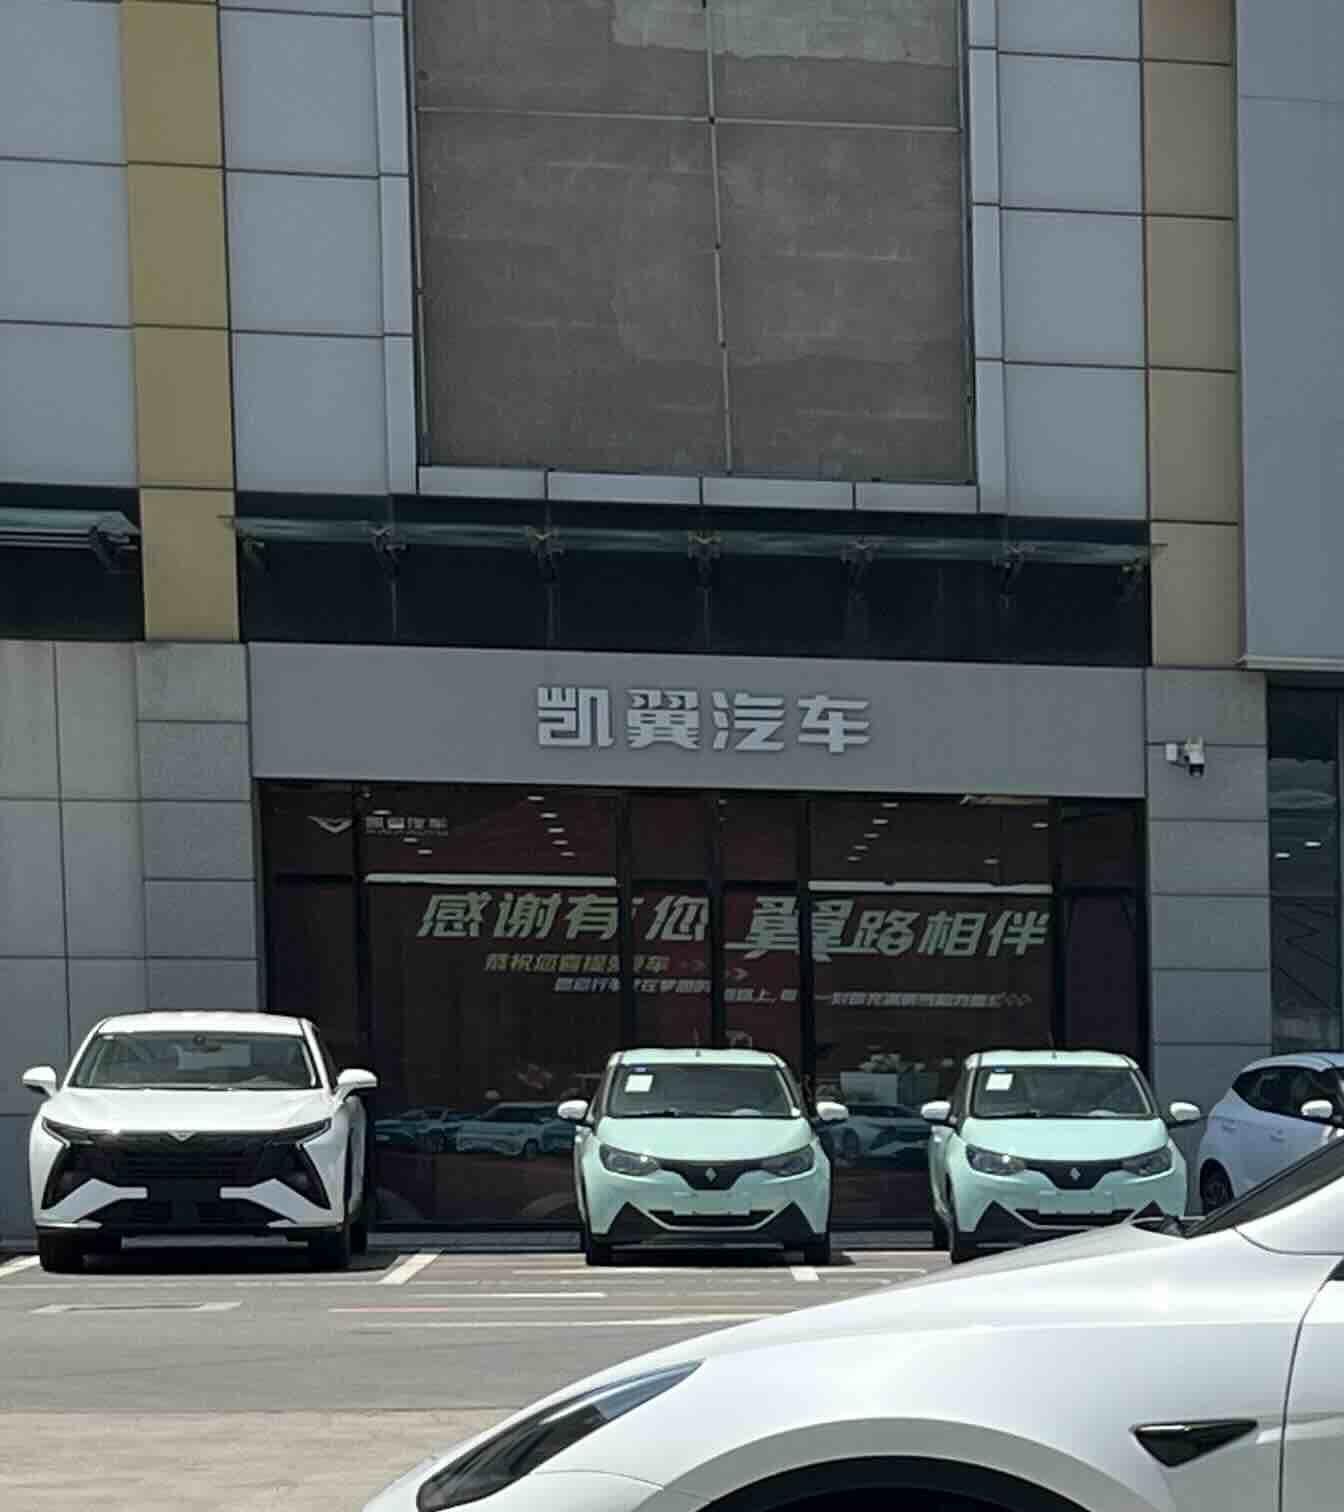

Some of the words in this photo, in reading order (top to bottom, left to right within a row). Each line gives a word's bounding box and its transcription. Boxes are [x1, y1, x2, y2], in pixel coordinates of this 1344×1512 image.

[537, 687, 870, 753] 凯翼汽车
[416, 891, 709, 941] 感谢有您
